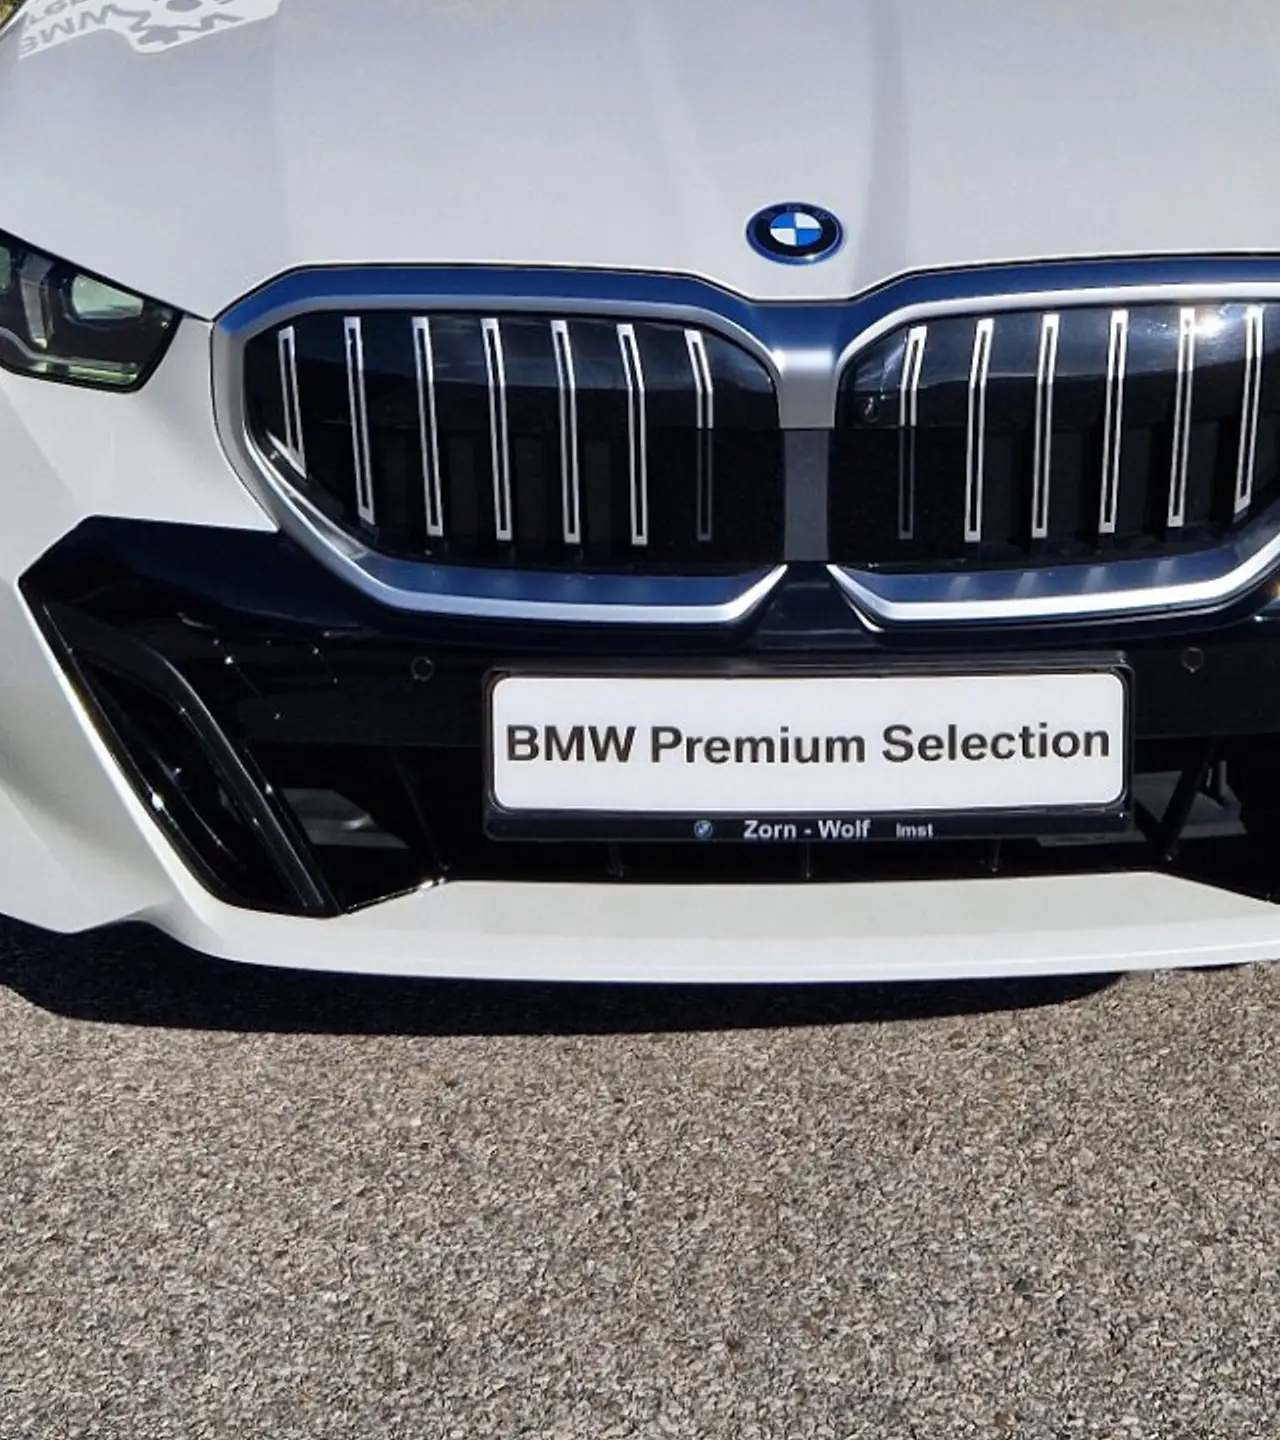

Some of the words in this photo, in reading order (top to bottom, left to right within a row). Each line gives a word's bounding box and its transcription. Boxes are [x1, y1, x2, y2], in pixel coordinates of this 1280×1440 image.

[508, 724, 636, 763] BMW
[651, 726, 865, 764] Premium
[882, 722, 1109, 763] Selection
[743, 819, 797, 840] Zorn
[817, 818, 872, 840] Wolf
